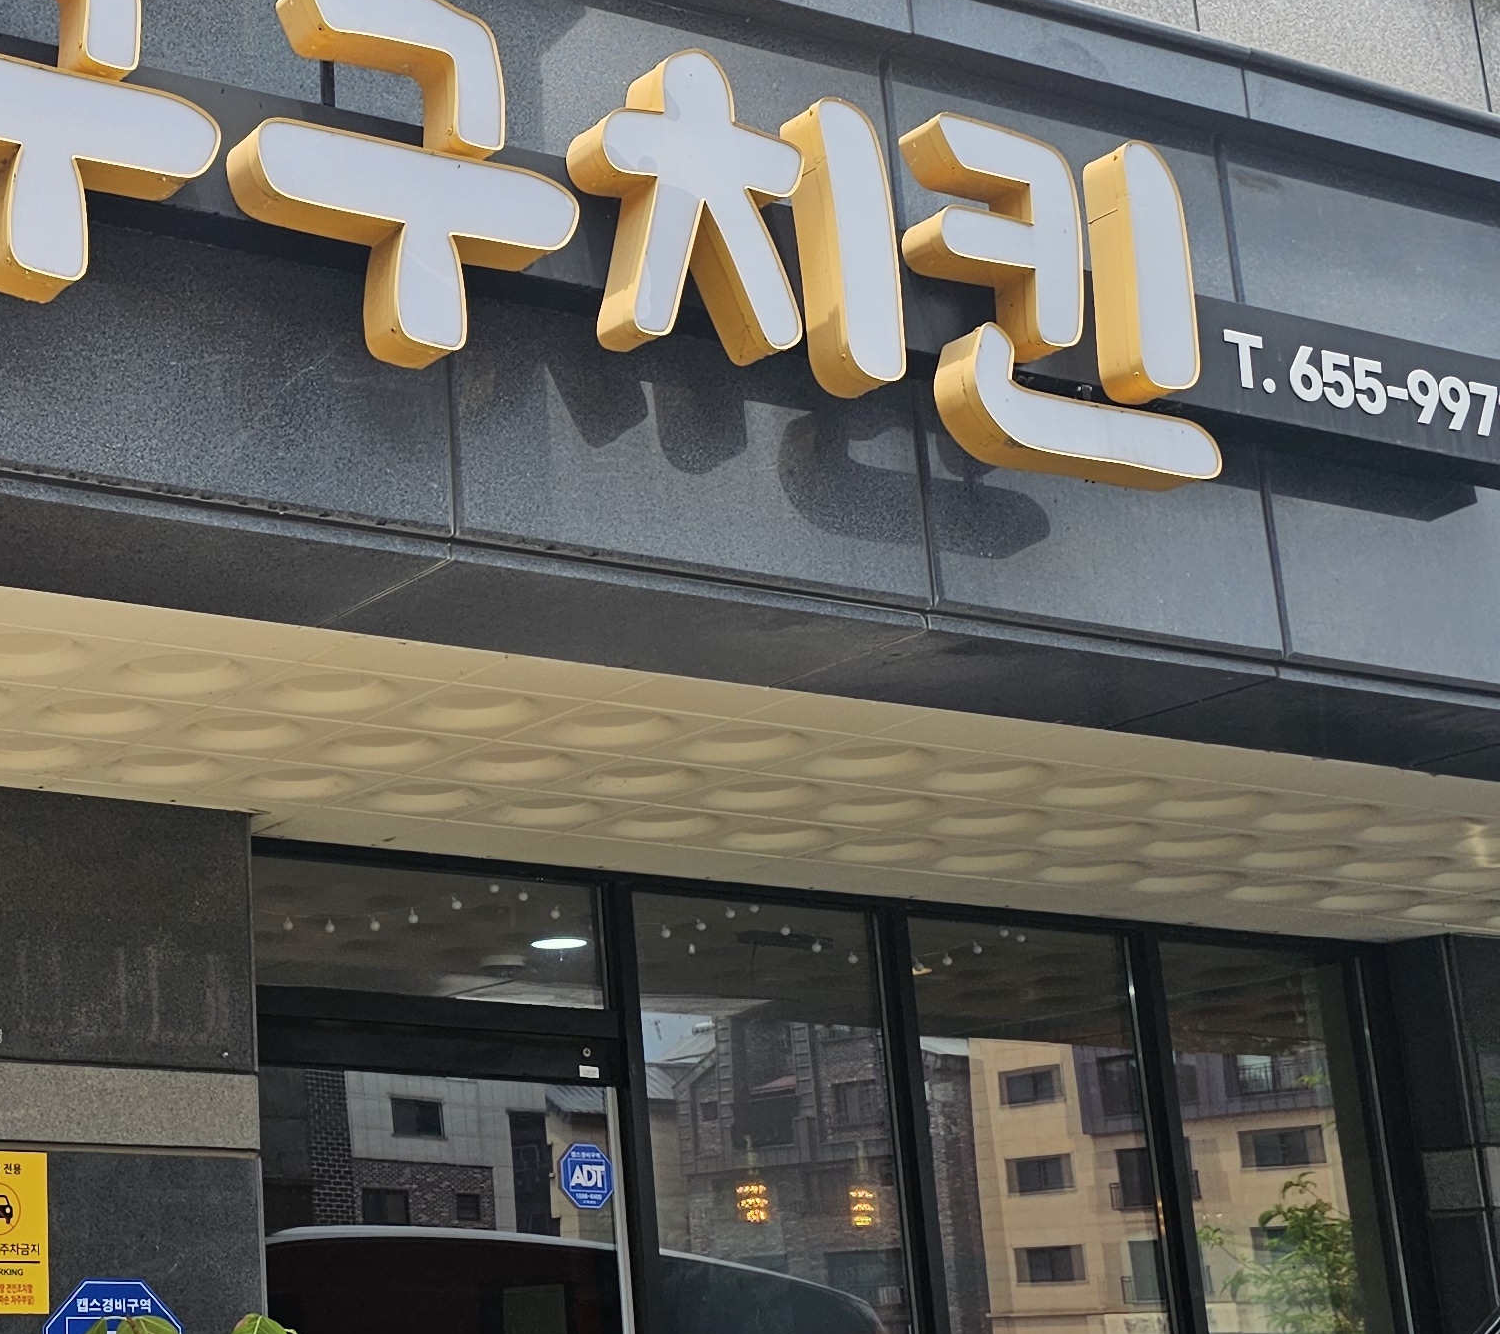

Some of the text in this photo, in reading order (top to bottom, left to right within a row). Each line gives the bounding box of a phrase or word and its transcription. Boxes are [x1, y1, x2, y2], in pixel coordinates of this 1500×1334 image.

[1223, 329, 1500, 437] T. 655-997
[4, 1163, 22, 1175] 전용
[570, 1164, 605, 1188] ADT
[0, 1243, 40, 1256] 주차금지
[76, 1297, 152, 1313] 캡스경비구역
